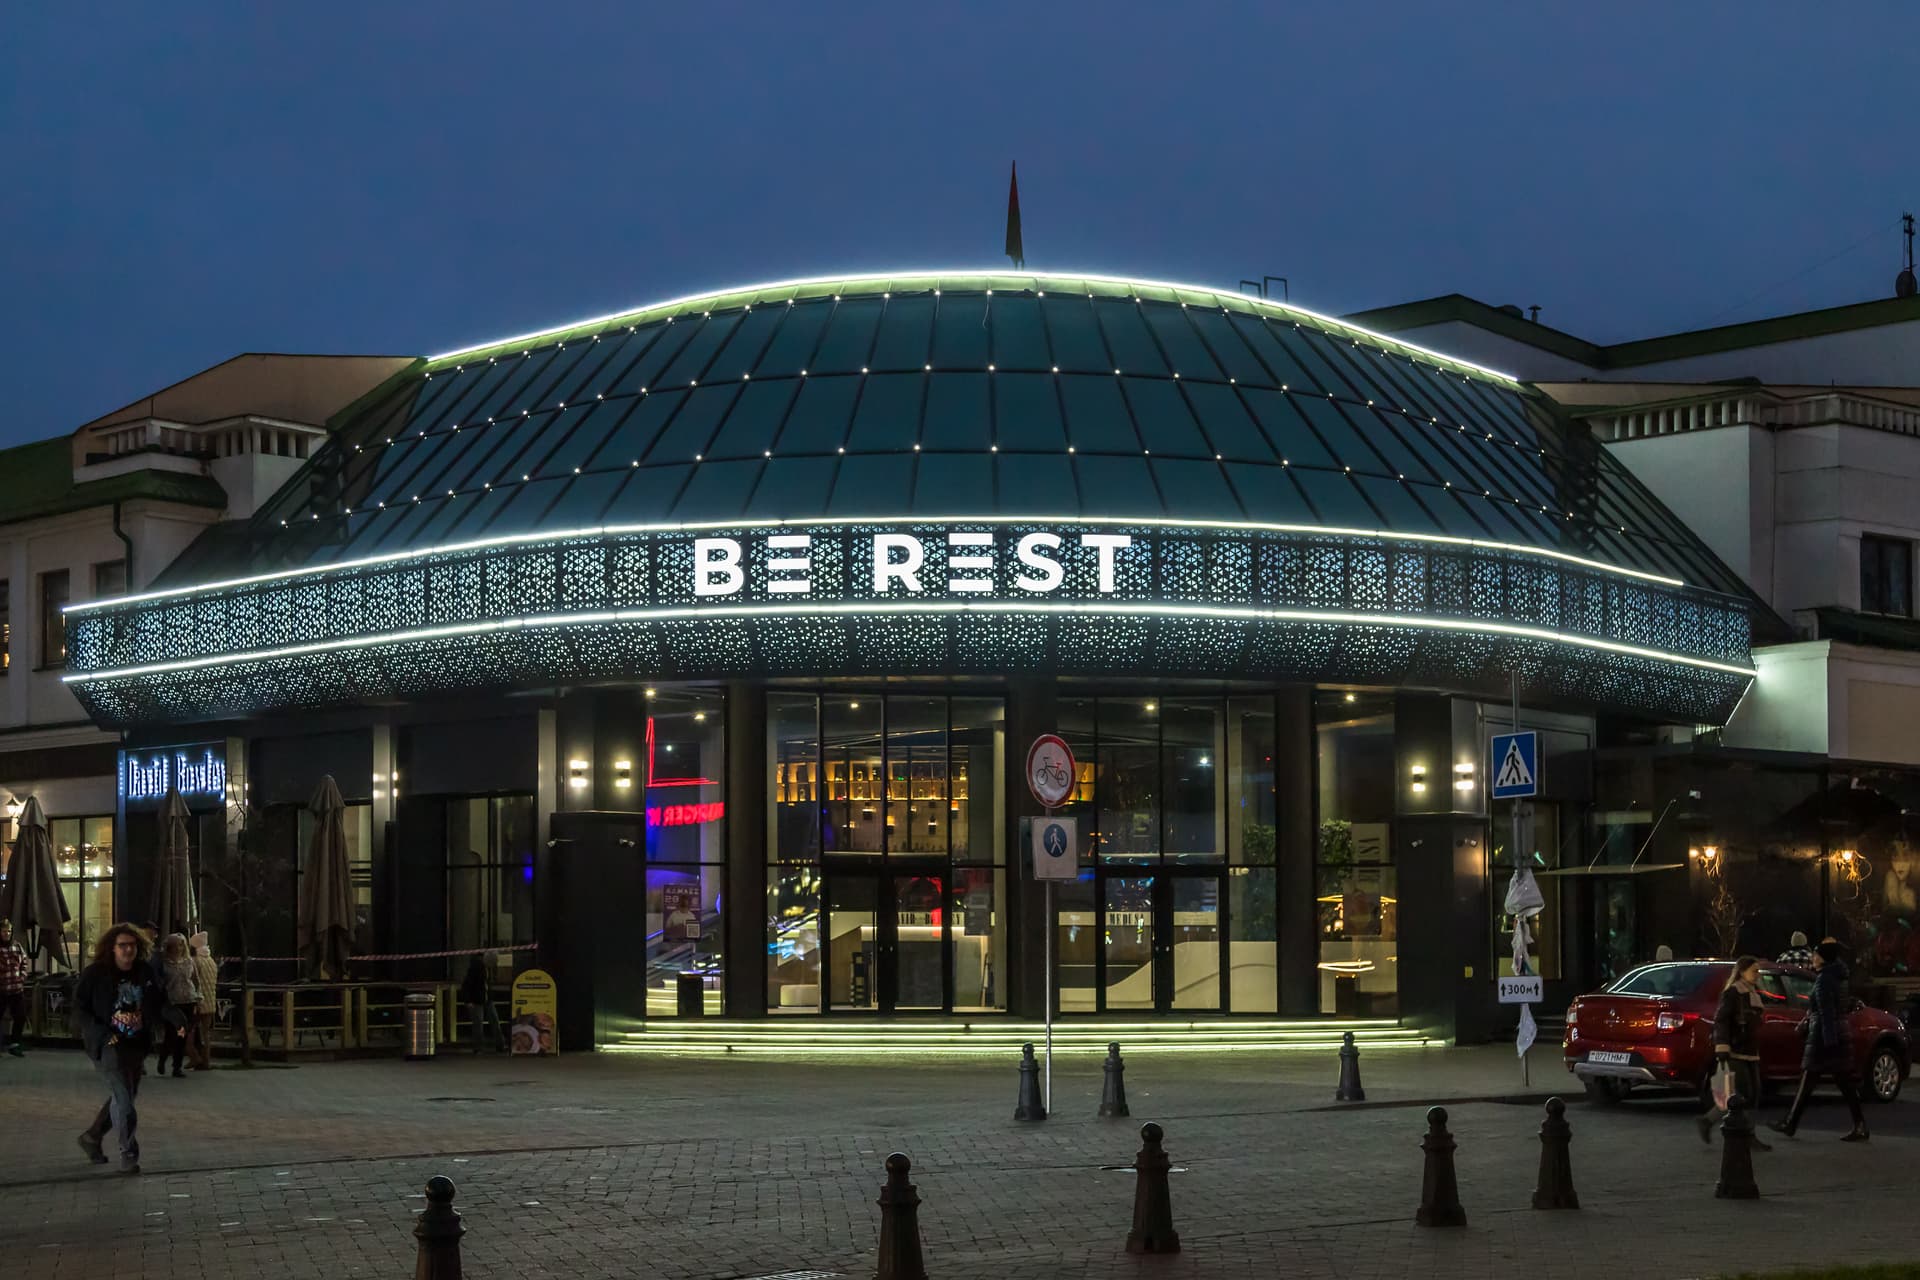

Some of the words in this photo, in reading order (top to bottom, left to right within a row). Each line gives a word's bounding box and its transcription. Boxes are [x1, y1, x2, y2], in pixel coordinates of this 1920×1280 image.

[694, 534, 811, 596] BE
[873, 532, 1132, 593] REST
[127, 757, 168, 797] David
